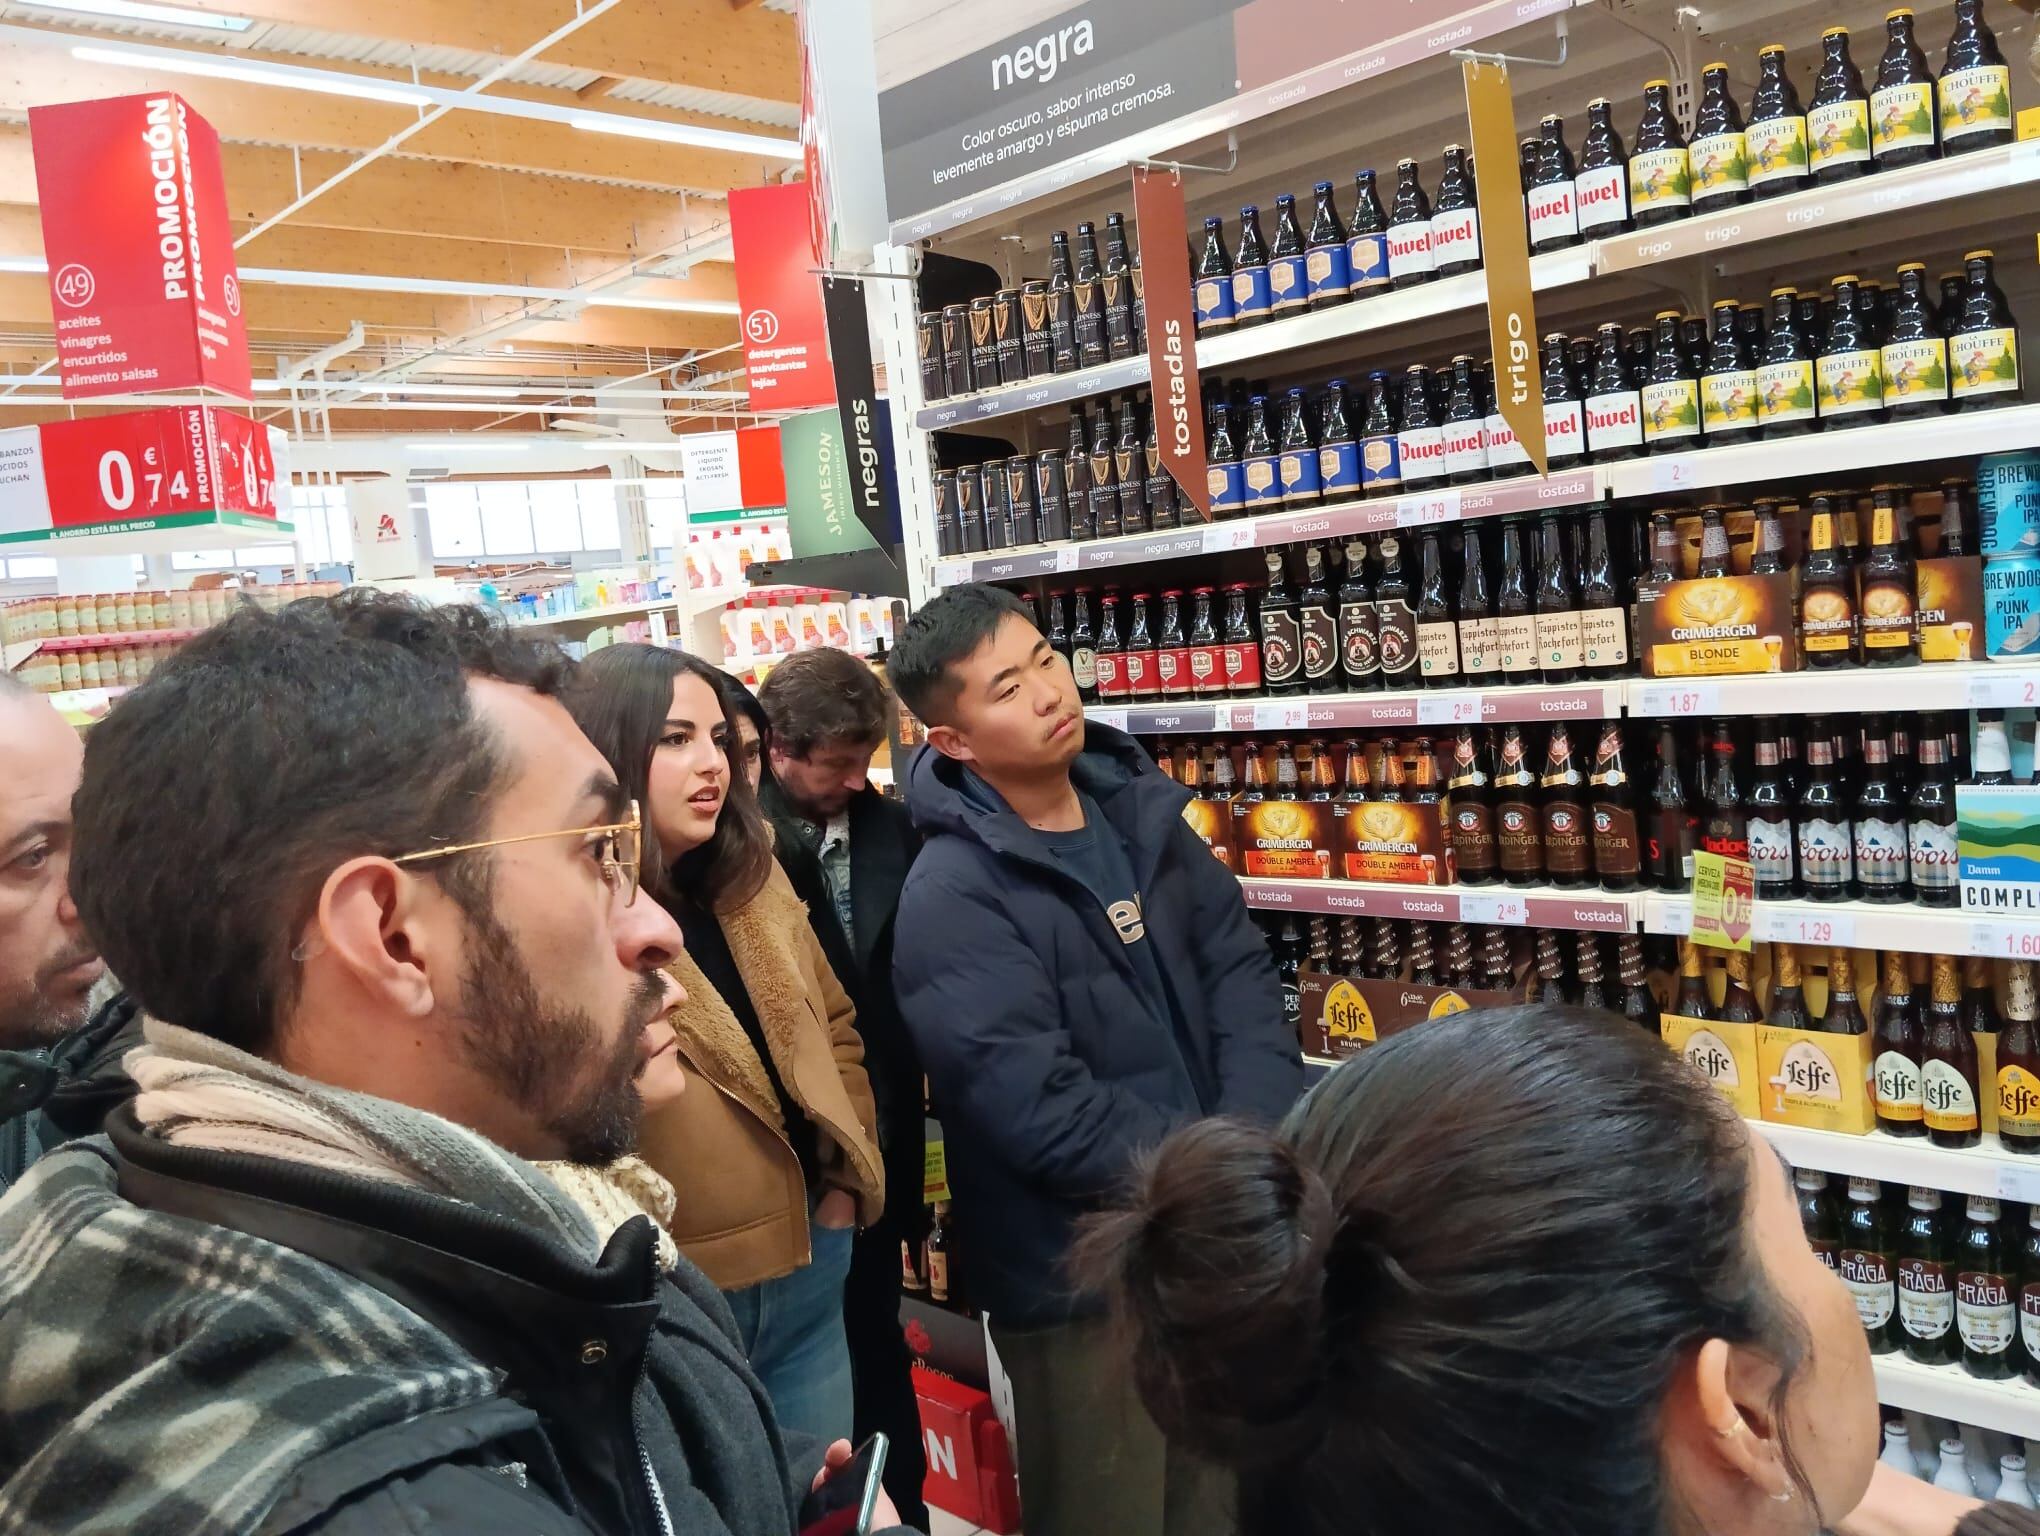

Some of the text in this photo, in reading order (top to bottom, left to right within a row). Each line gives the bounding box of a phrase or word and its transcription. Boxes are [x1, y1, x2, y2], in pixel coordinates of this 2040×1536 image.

[1427, 23, 1473, 48] tostada
[991, 19, 1095, 91] negra
[1343, 55, 1387, 78] tostada
[1945, 74, 2000, 92] CHOUFFE
[961, 72, 1136, 151] Color oscuro, sabor intenso
[932, 84, 1176, 185] levemente amargo y espuma cremosa.
[1692, 140, 1735, 158] HOUFFE
[145, 98, 189, 302] PROMOCIÓN
[999, 190, 1023, 204] negra
[952, 206, 974, 220] negra
[1785, 204, 1825, 223] trigo
[911, 220, 933, 235] negra
[1704, 223, 1740, 242] trigo
[1388, 232, 1431, 259] Duvel
[1637, 239, 1672, 257] trigo
[61, 276, 90, 298] 49
[58, 314, 102, 331] aceites
[751, 317, 771, 337] 51
[60, 332, 113, 351] vinagres
[63, 349, 128, 368] encurtidos
[748, 346, 807, 360] detergentes
[1507, 312, 1530, 405] trigo
[1884, 347, 1934, 362] CHOUFFE
[750, 361, 807, 375] suavizantes
[1820, 358, 1871, 373] CHOUFFE
[65, 367, 159, 388] alimento salsas
[1077, 375, 1101, 391] negra
[1708, 376, 1756, 392] CHOUFFE
[1026, 388, 1049, 402] negra
[1164, 319, 1191, 457] tostadas
[1647, 387, 1687, 401] HOUFFE
[936, 408, 957, 422] negra
[977, 399, 999, 414] negra
[1545, 413, 1577, 436] vel
[1586, 403, 1637, 431] Duvel
[188, 409, 209, 503] PROMOCIÓN
[853, 398, 880, 507] negras
[1401, 440, 1443, 462] Duve
[99, 450, 135, 511] 0
[819, 431, 842, 536] JAMESON
[1537, 481, 1586, 499] tostada
[1420, 502, 1445, 520] 1.79
[1461, 495, 1494, 510] stada
[1977, 468, 1998, 549] BREWDOG
[1292, 519, 1330, 535] tostada
[1144, 541, 1170, 556] negra
[1174, 539, 1200, 552] negra
[1232, 533, 1239, 546] 2
[1090, 550, 1114, 562] negra
[991, 564, 1013, 575] negra
[1995, 600, 2030, 615] PUNK
[2003, 615, 2024, 630] IPA
[1671, 624, 1757, 640] GRIMBERGEN
[1690, 648, 1740, 660] BLONDE
[2024, 683, 2034, 702] 2
[1454, 703, 1473, 721] 2 69
[1540, 698, 1588, 712] tostada
[1670, 693, 1699, 713] 1.87
[1155, 715, 1181, 728] negra
[1285, 711, 1291, 726] 2
[1308, 709, 1335, 721] stada
[1371, 707, 1413, 719] tostada
[1256, 838, 1313, 849] GRIMBERGEN
[1358, 840, 1418, 854] GRIMBERGEN
[1750, 845, 1789, 860] oors
[1800, 839, 1849, 862] Coors
[1856, 839, 1905, 863] Coors
[1909, 840, 1959, 865] Coors
[1256, 857, 1284, 865] DOUBLE
[1356, 860, 1387, 869] DOUBLE
[1967, 864, 2001, 875] Damm
[1257, 890, 1292, 903] tostada
[1327, 895, 1365, 907] tostada
[1403, 900, 1444, 912] tostada
[1498, 904, 1517, 920] 2 49
[1574, 908, 1622, 923] tostada
[1800, 922, 1831, 942] 1.29
[1329, 1002, 1366, 1033] Leffe
[1786, 1060, 1831, 1092] Leffe
[1877, 1070, 1917, 1101] Leffe
[1923, 1078, 1962, 1110] Leffe
[1841, 1260, 1887, 1283] PRAGA
[1899, 1268, 1946, 1292] PRAGA
[1958, 1281, 2008, 1305] PRAGA
